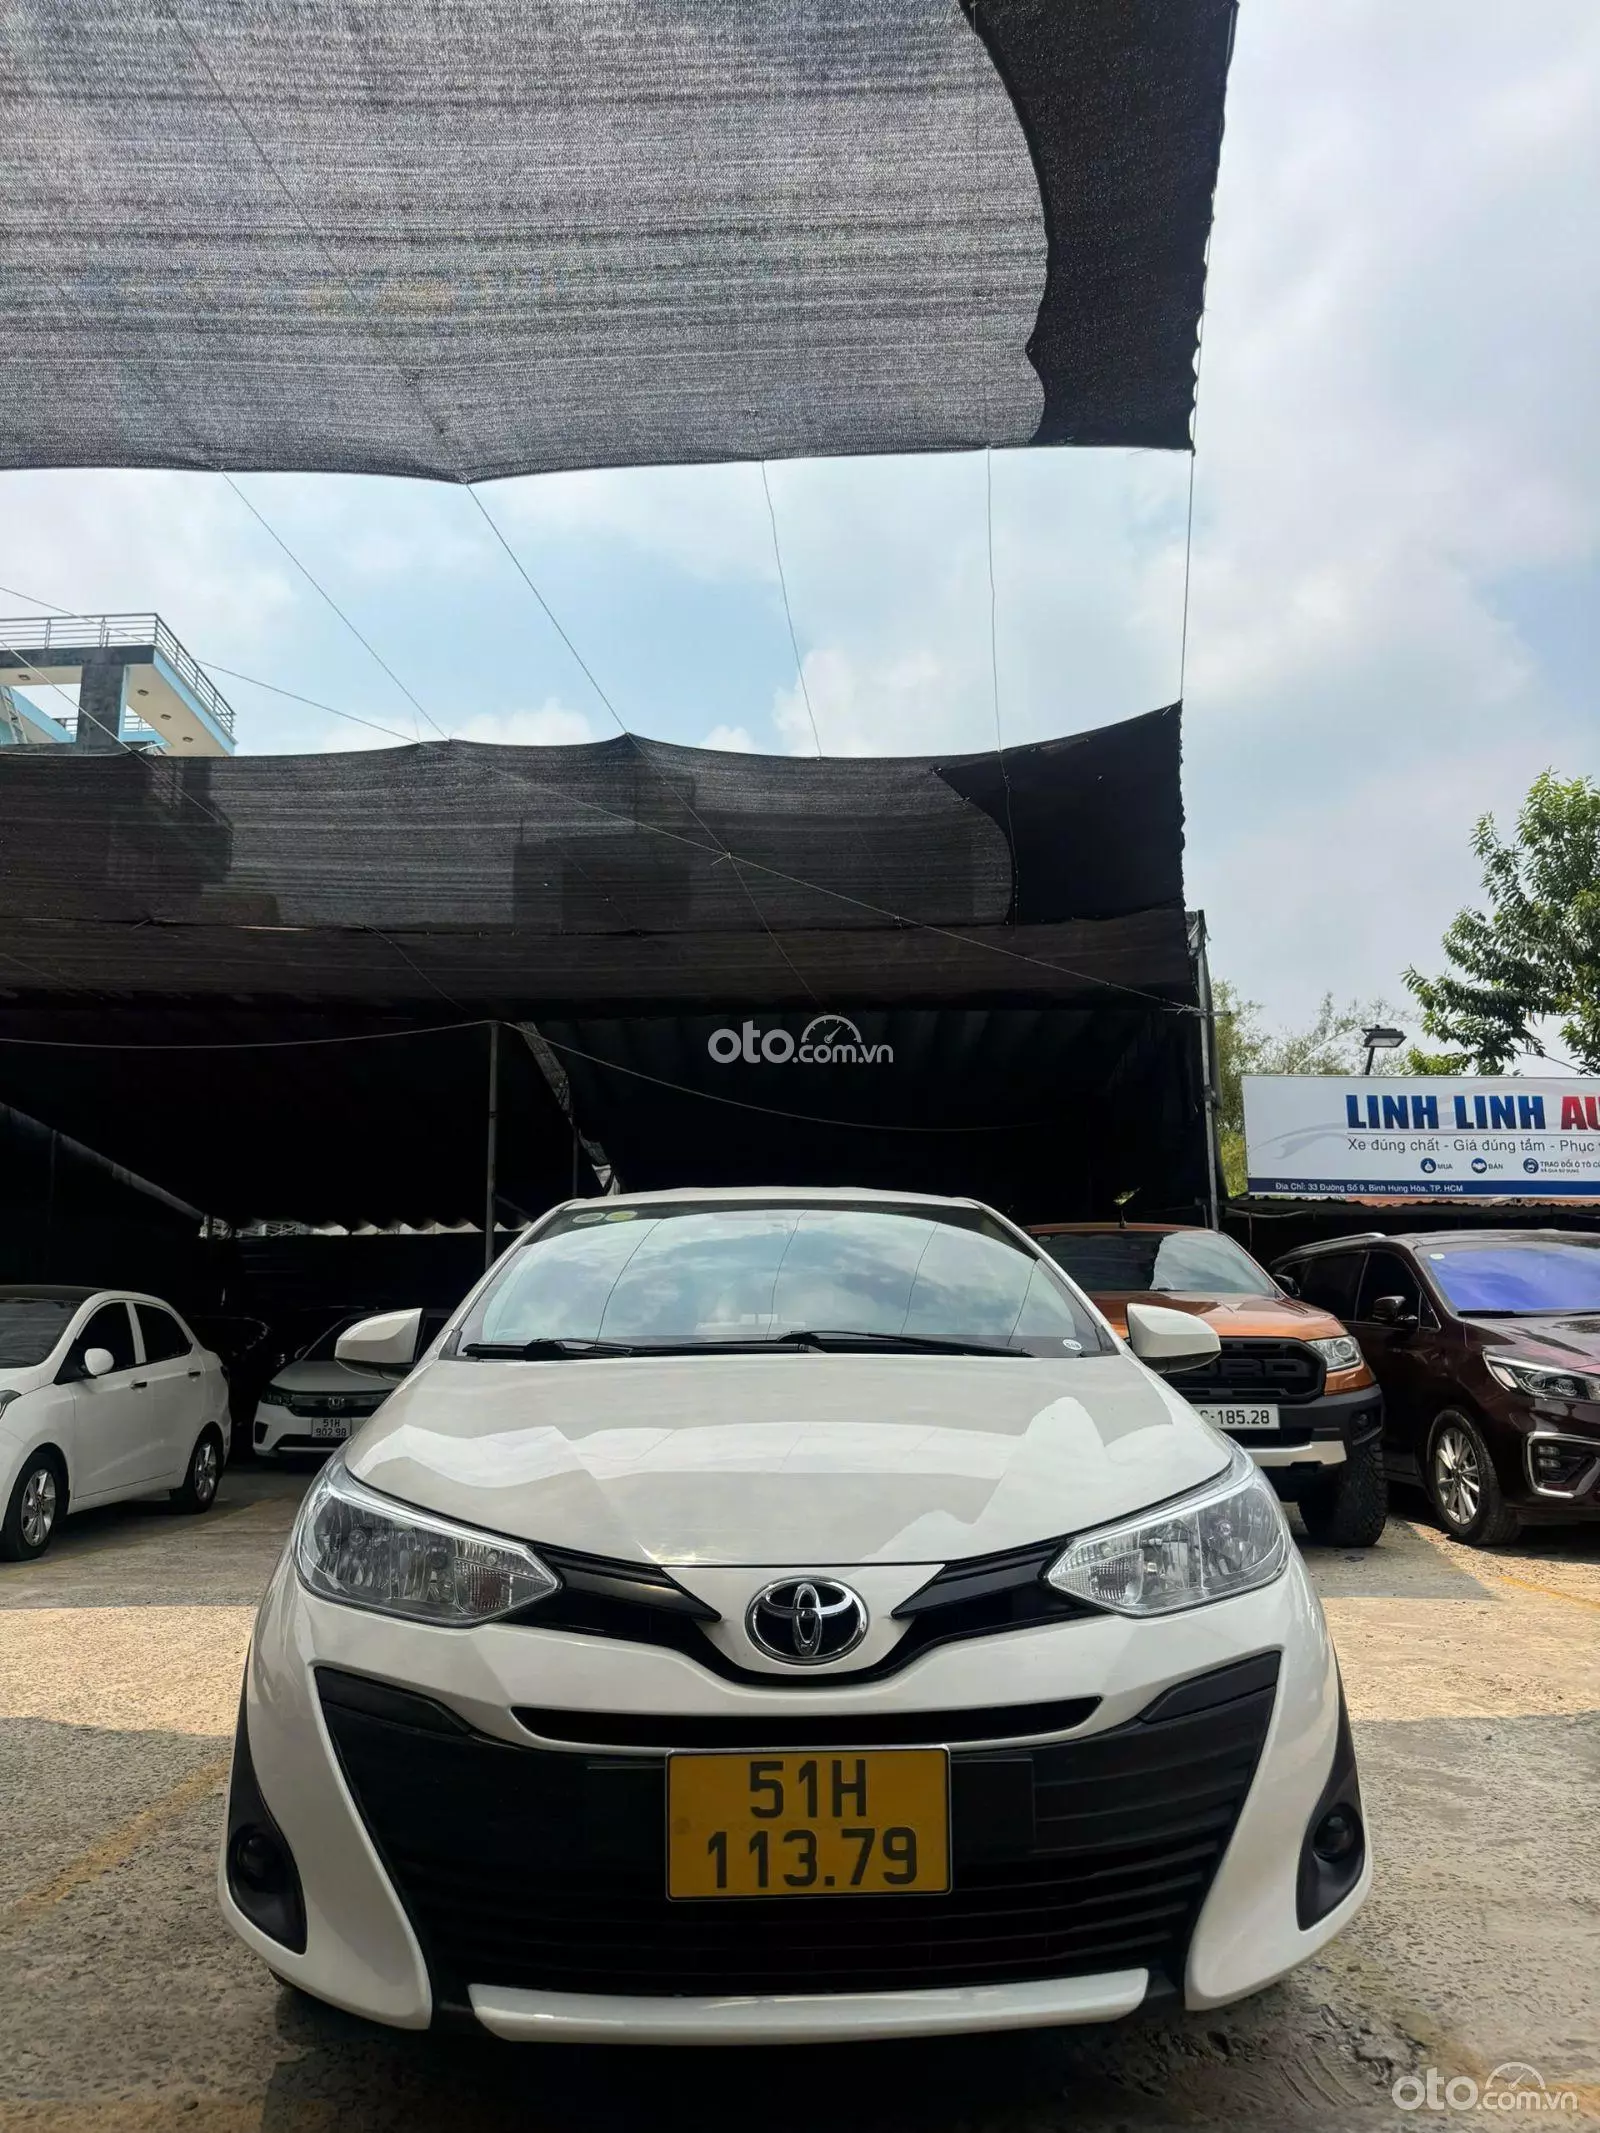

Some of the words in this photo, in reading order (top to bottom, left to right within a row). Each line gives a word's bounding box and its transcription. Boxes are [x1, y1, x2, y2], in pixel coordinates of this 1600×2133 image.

[1346, 1094, 1440, 1130] LINH
[1453, 1095, 1547, 1130] LINH
[1348, 1138, 1367, 1151] Xe
[1371, 1138, 1406, 1154] đúng
[1410, 1137, 1440, 1152] chất
[1453, 1138, 1478, 1152] Giá
[1482, 1138, 1516, 1154] đúng
[1560, 1139, 1595, 1154] Phục
[1437, 1162, 1453, 1170] MUA
[1275, 1182, 1289, 1191] Địa
[1308, 1183, 1318, 1191] 33
[1444, 1184, 1464, 1193] HCM
[323, 1418, 340, 1428] 51H
[750, 1759, 867, 1818] 51H
[707, 1827, 918, 1889] 113.79
